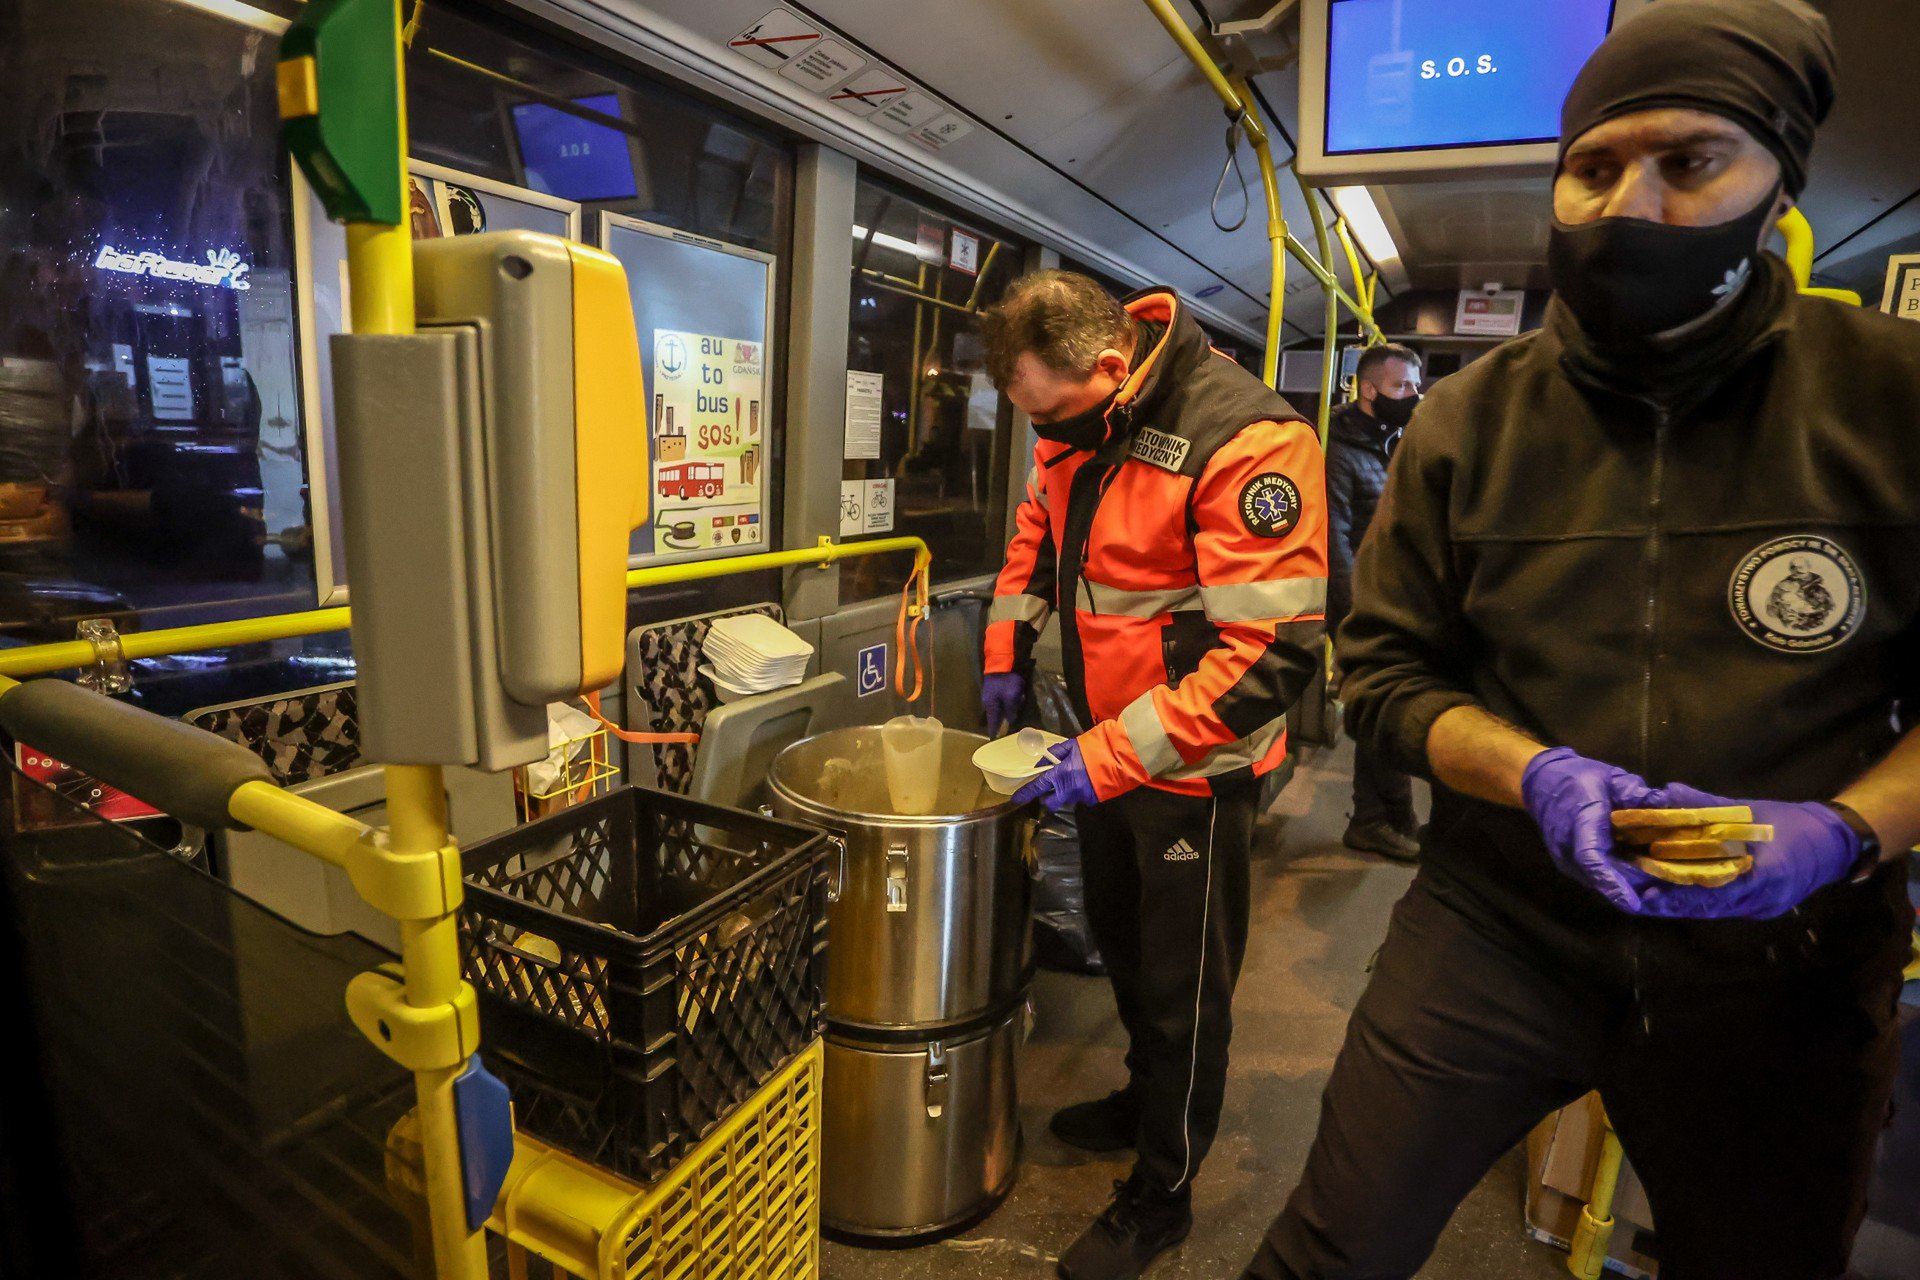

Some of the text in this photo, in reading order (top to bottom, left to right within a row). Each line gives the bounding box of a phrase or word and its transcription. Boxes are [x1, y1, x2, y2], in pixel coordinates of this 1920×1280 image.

[701, 337, 723, 356] au
[702, 364, 723, 385] to
[697, 389, 729, 414] bus
[1135, 442, 1181, 466] EDYCZNY
[1139, 429, 1186, 455] ATOWNIK
[1245, 477, 1298, 526] RATOWNIK MEDYCZNY
[1163, 851, 1200, 861] adidas
